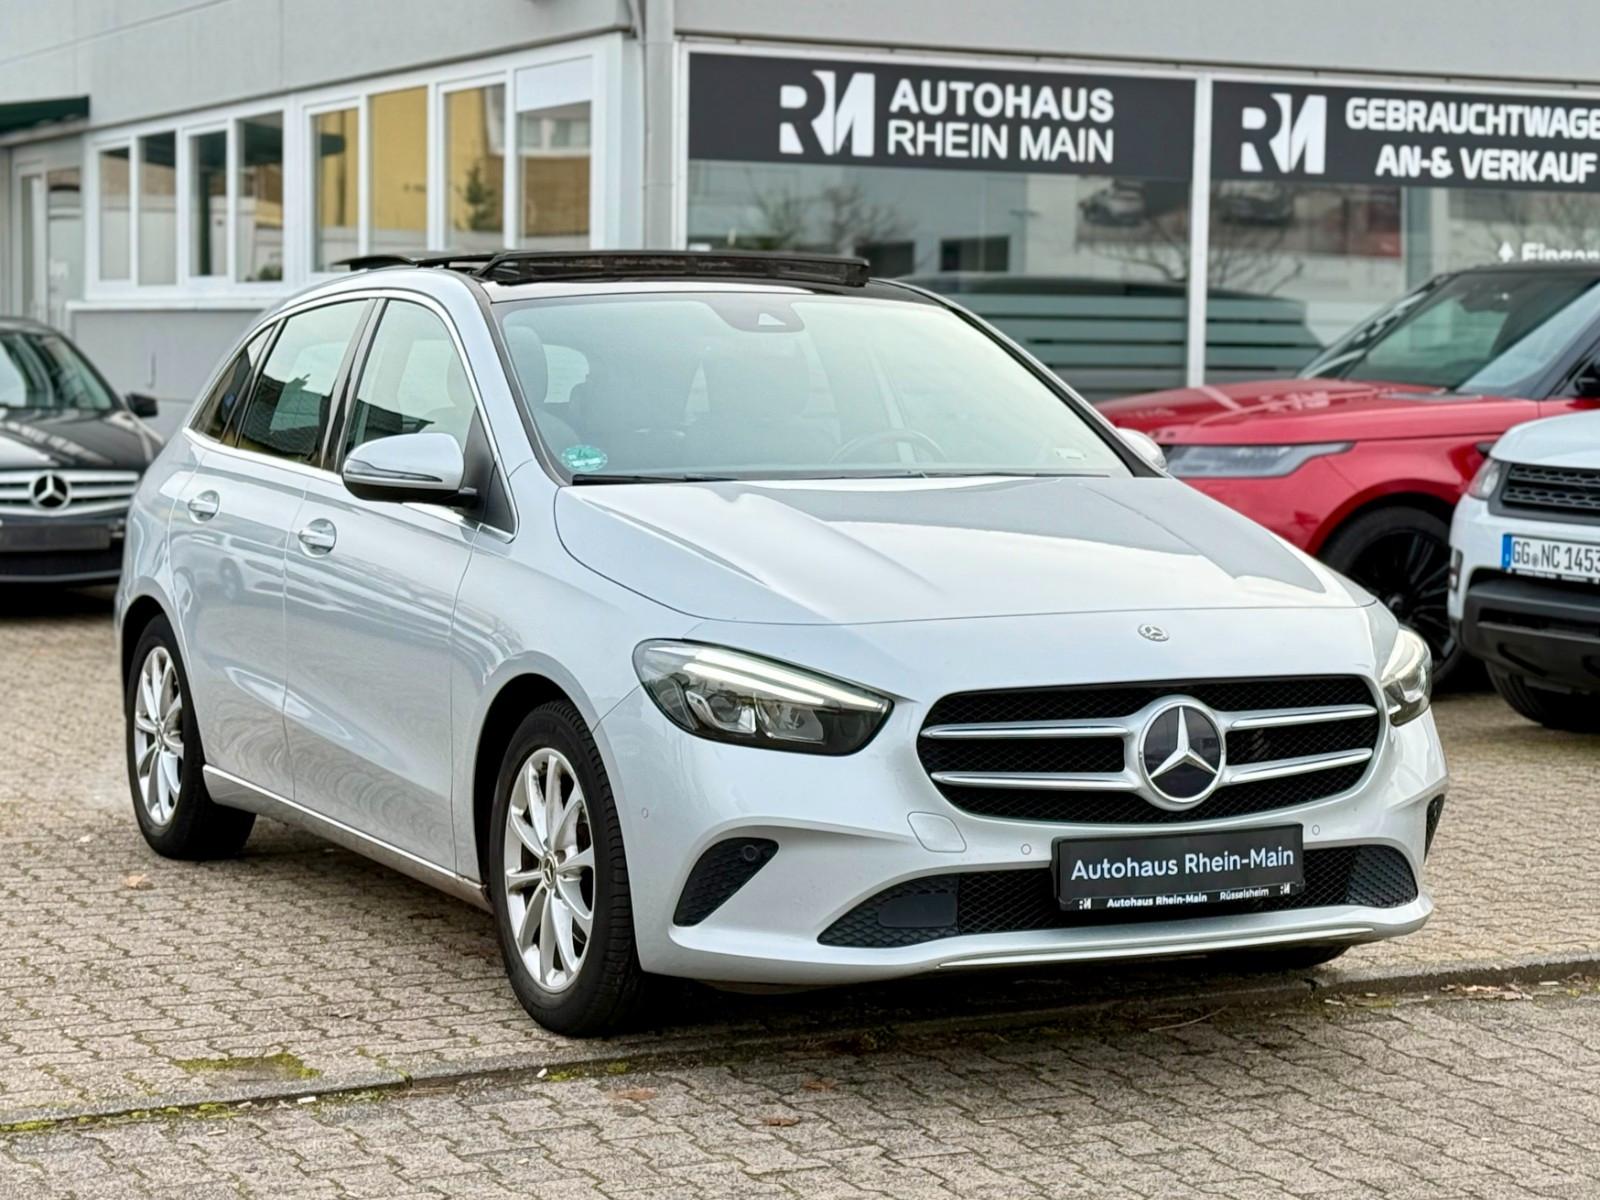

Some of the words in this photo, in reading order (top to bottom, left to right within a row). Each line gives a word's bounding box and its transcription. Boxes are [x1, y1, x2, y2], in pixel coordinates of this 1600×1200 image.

[889, 79, 1114, 122] AUTOHAUS
[1345, 97, 1600, 139] GEBRAUCHTWAGE
[887, 119, 1008, 159] RHEIN
[1020, 126, 1114, 164] MAIN
[1374, 144, 1454, 179] AN-&
[1459, 148, 1598, 184] VERKAUF
[1513, 541, 1530, 564] GG
[1541, 544, 1560, 568] NC
[1071, 858, 1178, 880] Autohaus
[1184, 846, 1294, 874] Rhein-Main
[1107, 898, 1153, 908] Autohaus
[1155, 892, 1208, 906] Rhein-Main
[1220, 887, 1269, 900] Rüsselsheim
